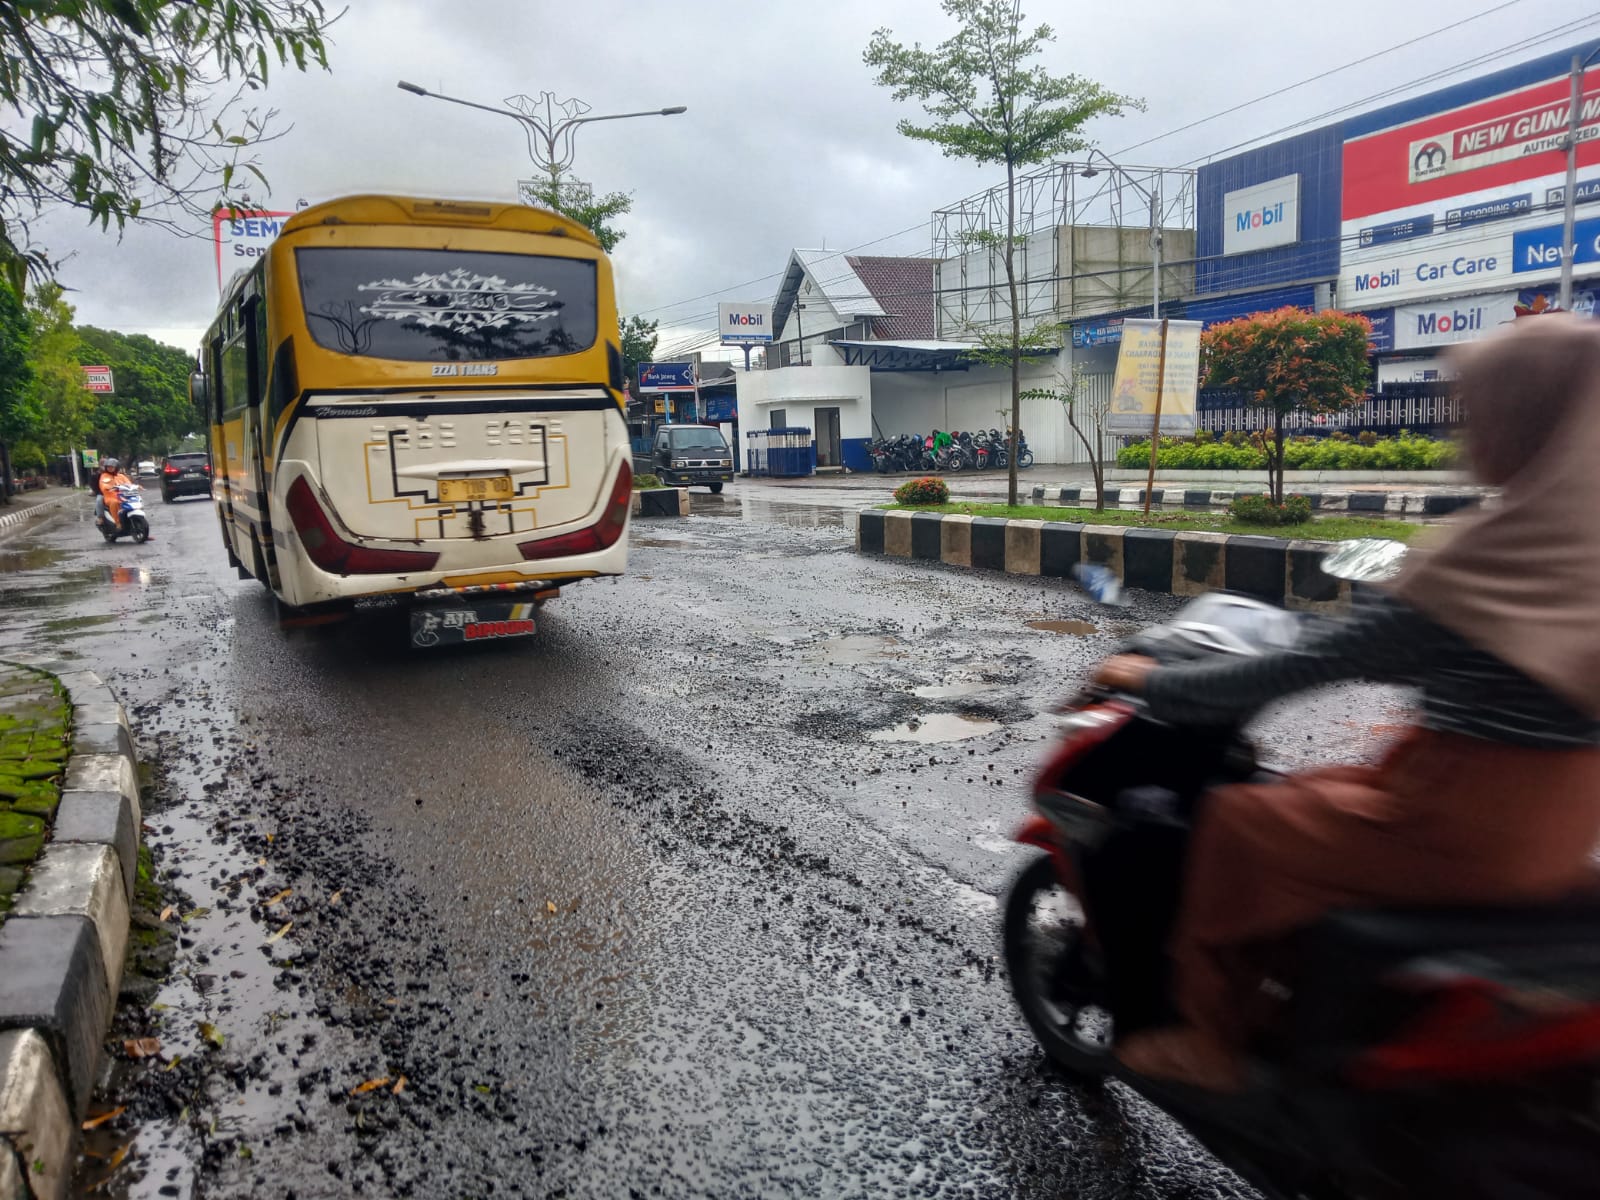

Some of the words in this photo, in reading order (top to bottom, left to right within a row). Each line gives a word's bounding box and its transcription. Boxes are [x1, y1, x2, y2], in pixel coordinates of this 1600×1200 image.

[1459, 122, 1510, 154] NEW
[231, 219, 284, 238] SEM
[1236, 202, 1283, 232] Mobil
[1355, 269, 1400, 292] Mobil
[1416, 263, 1447, 282] Car
[1452, 256, 1497, 275] Care
[729, 313, 763, 326] Mobil
[1417, 307, 1482, 335] Mobil
[461, 363, 498, 377] TRANS
